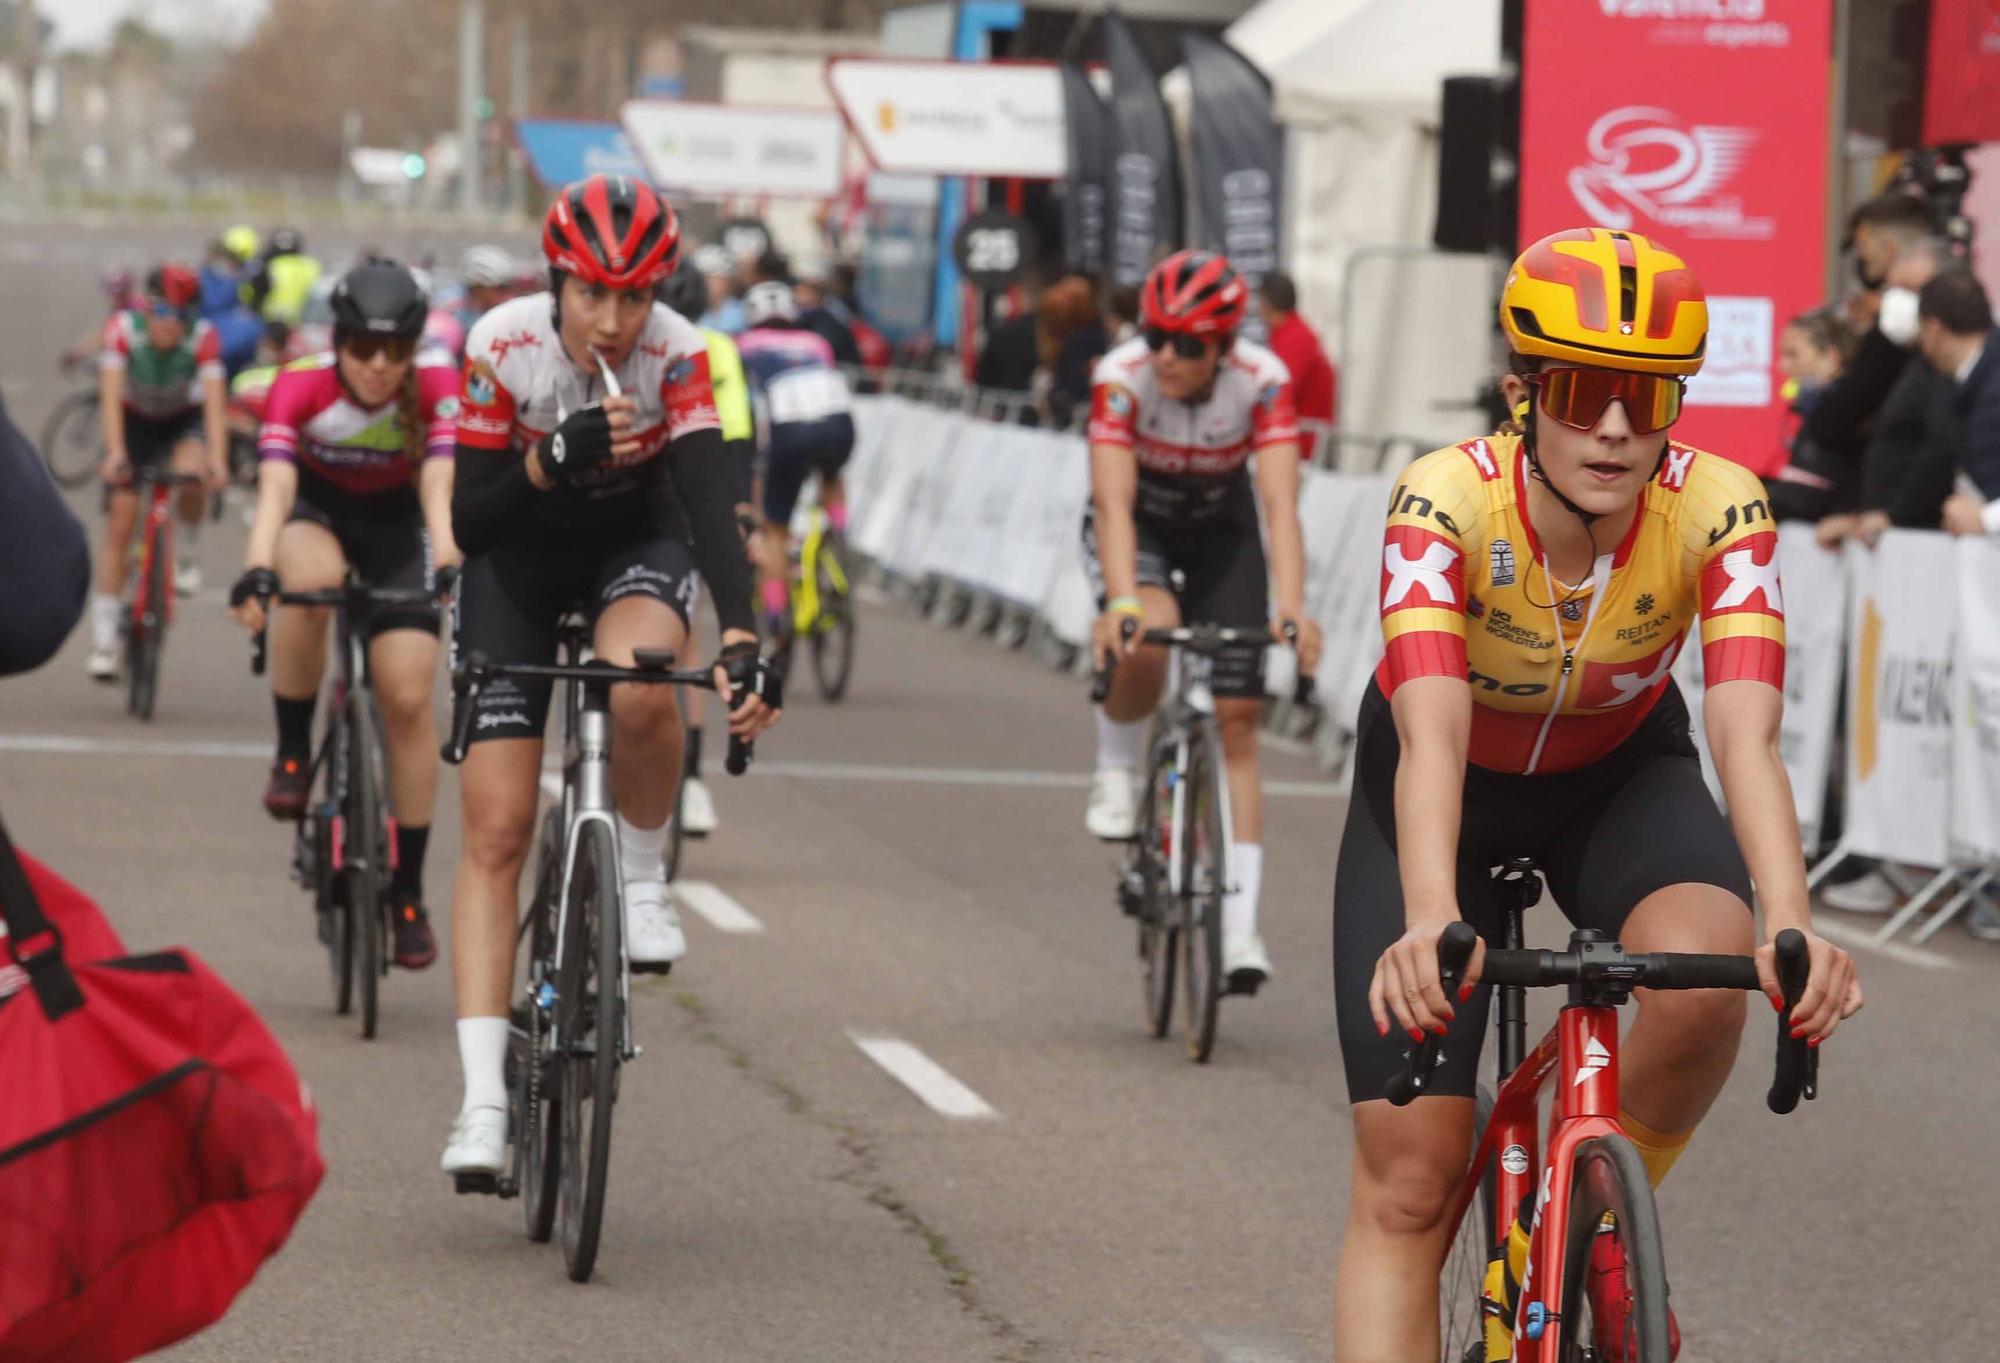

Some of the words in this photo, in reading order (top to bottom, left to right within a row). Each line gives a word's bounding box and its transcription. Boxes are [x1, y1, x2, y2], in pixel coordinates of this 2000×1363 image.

[1491, 608, 1511, 622] UCI
[1616, 611, 1672, 641] REITAN
[1485, 623, 1556, 650] WORLDTEAM
[1487, 616, 1541, 641] WOMEN'S
